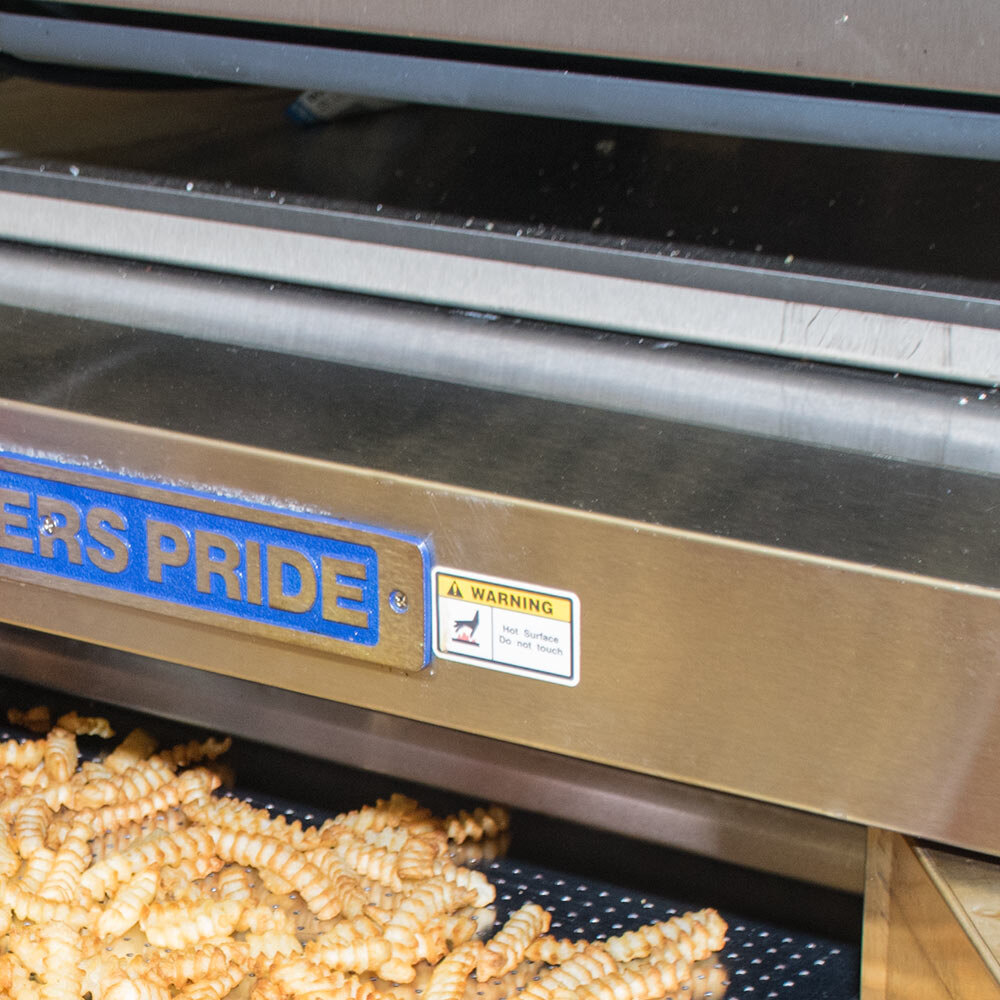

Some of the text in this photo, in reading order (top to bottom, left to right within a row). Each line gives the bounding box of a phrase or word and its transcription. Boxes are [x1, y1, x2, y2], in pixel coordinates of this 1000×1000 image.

[146, 519, 369, 629] PRIDE
[471, 585, 554, 616] WARNING
[499, 635, 564, 656] Do not touch
[502, 625, 559, 644] Hot Surface
